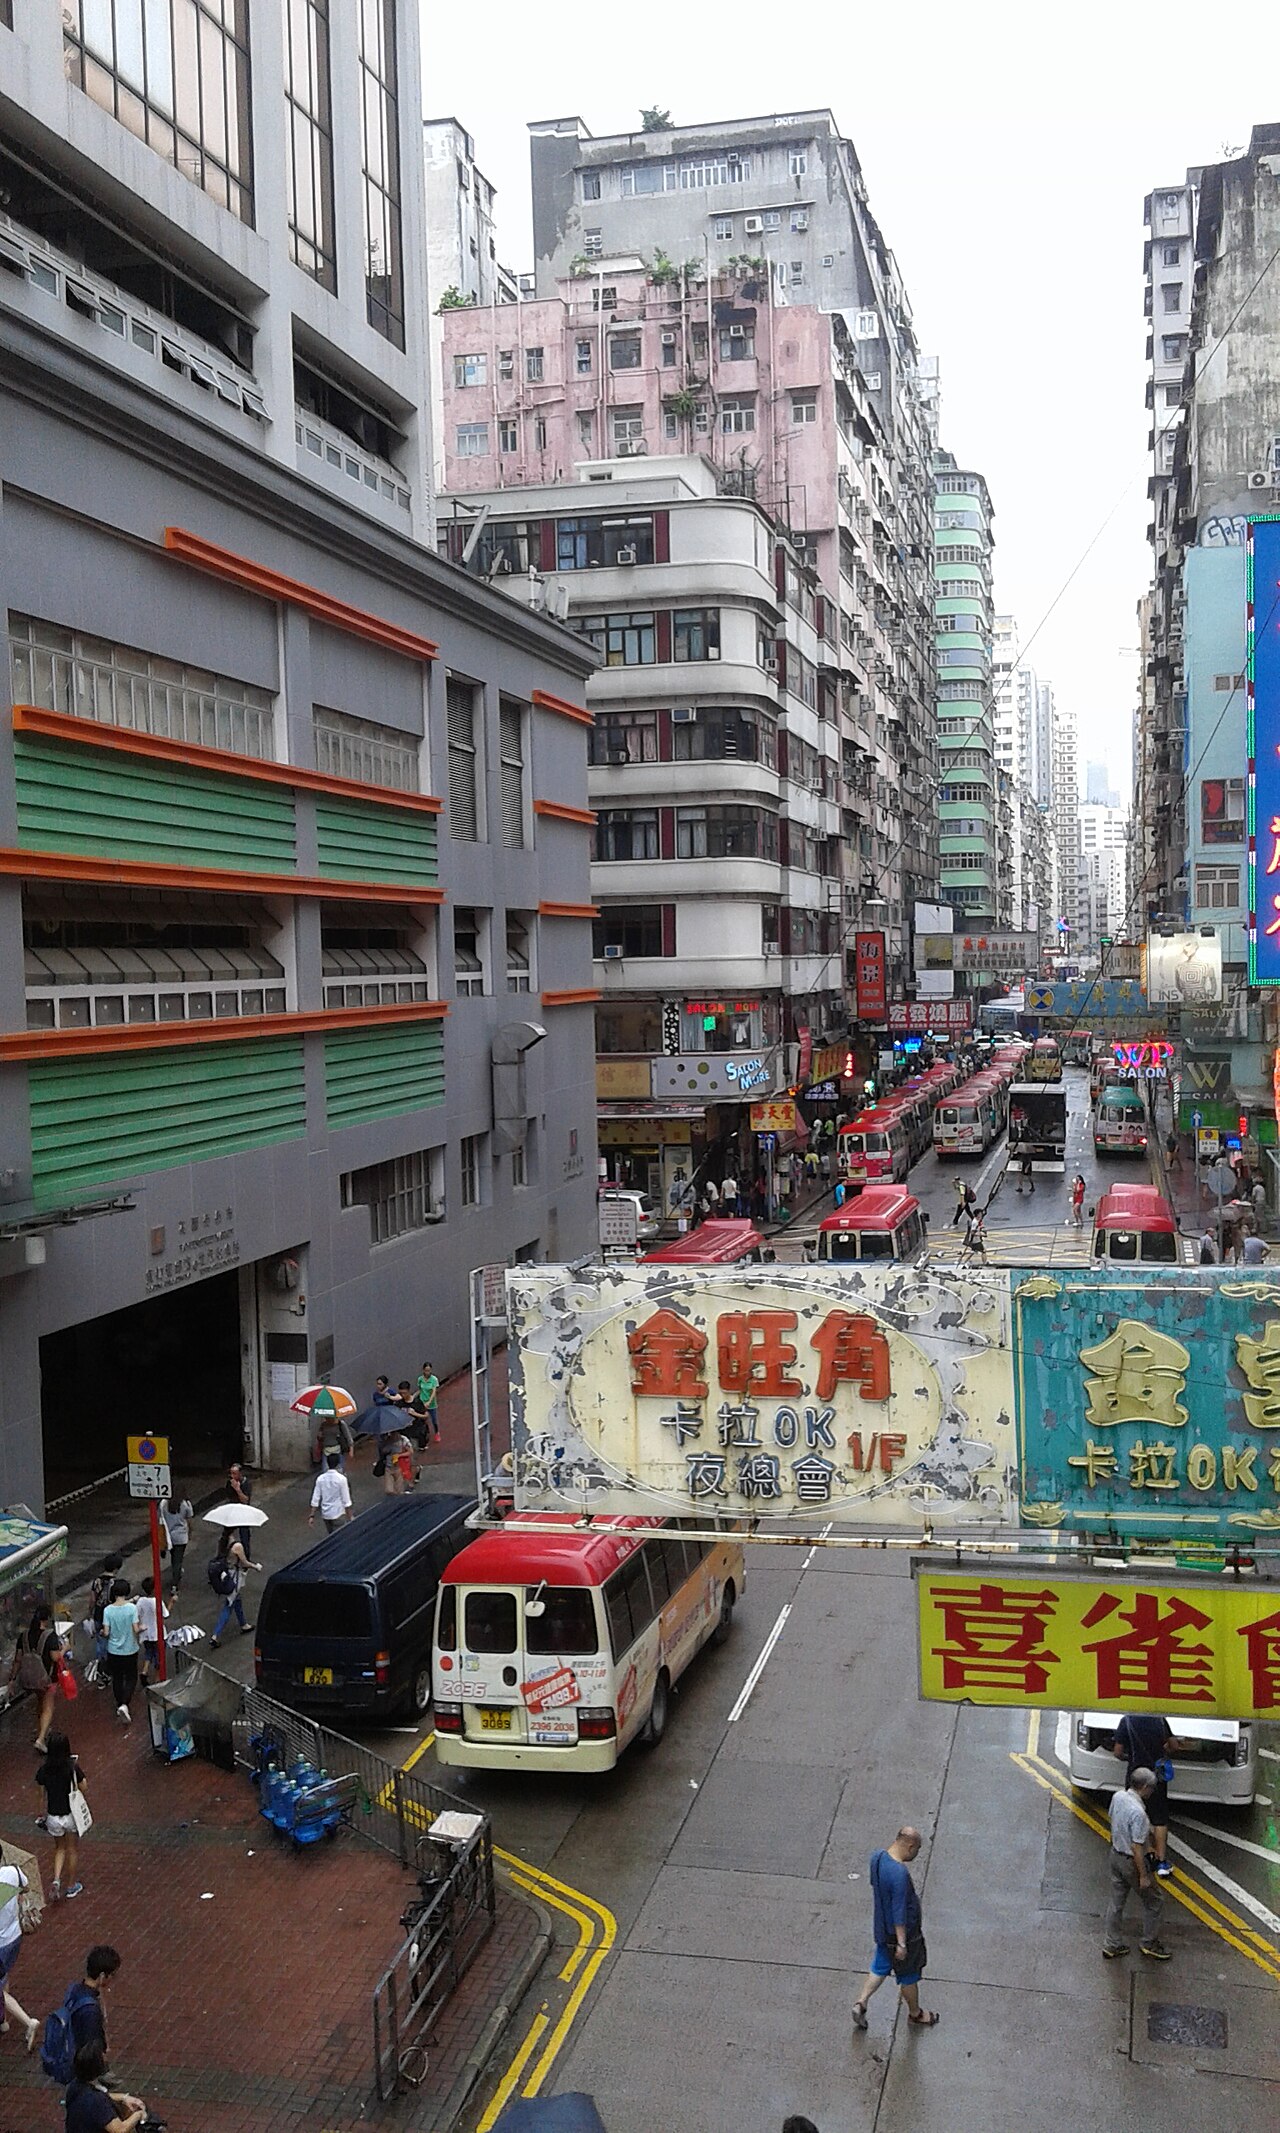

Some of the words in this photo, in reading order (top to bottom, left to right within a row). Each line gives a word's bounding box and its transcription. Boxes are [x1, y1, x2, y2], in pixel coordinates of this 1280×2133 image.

[726, 1059, 762, 1081] SALON
[740, 1069, 771, 1090] MORE
[1118, 1068, 1167, 1079] SALON
[627, 1308, 892, 1402] 金旺角
[660, 1401, 836, 1448] 卡拉OK
[846, 1430, 908, 1474] 1/F
[154, 1466, 162, 1477] 7
[684, 1451, 836, 1501] 夜總會
[1068, 1438, 1280, 1493] 卡拉OK
[155, 1484, 169, 1496] 12
[440, 1679, 487, 1698] 2036
